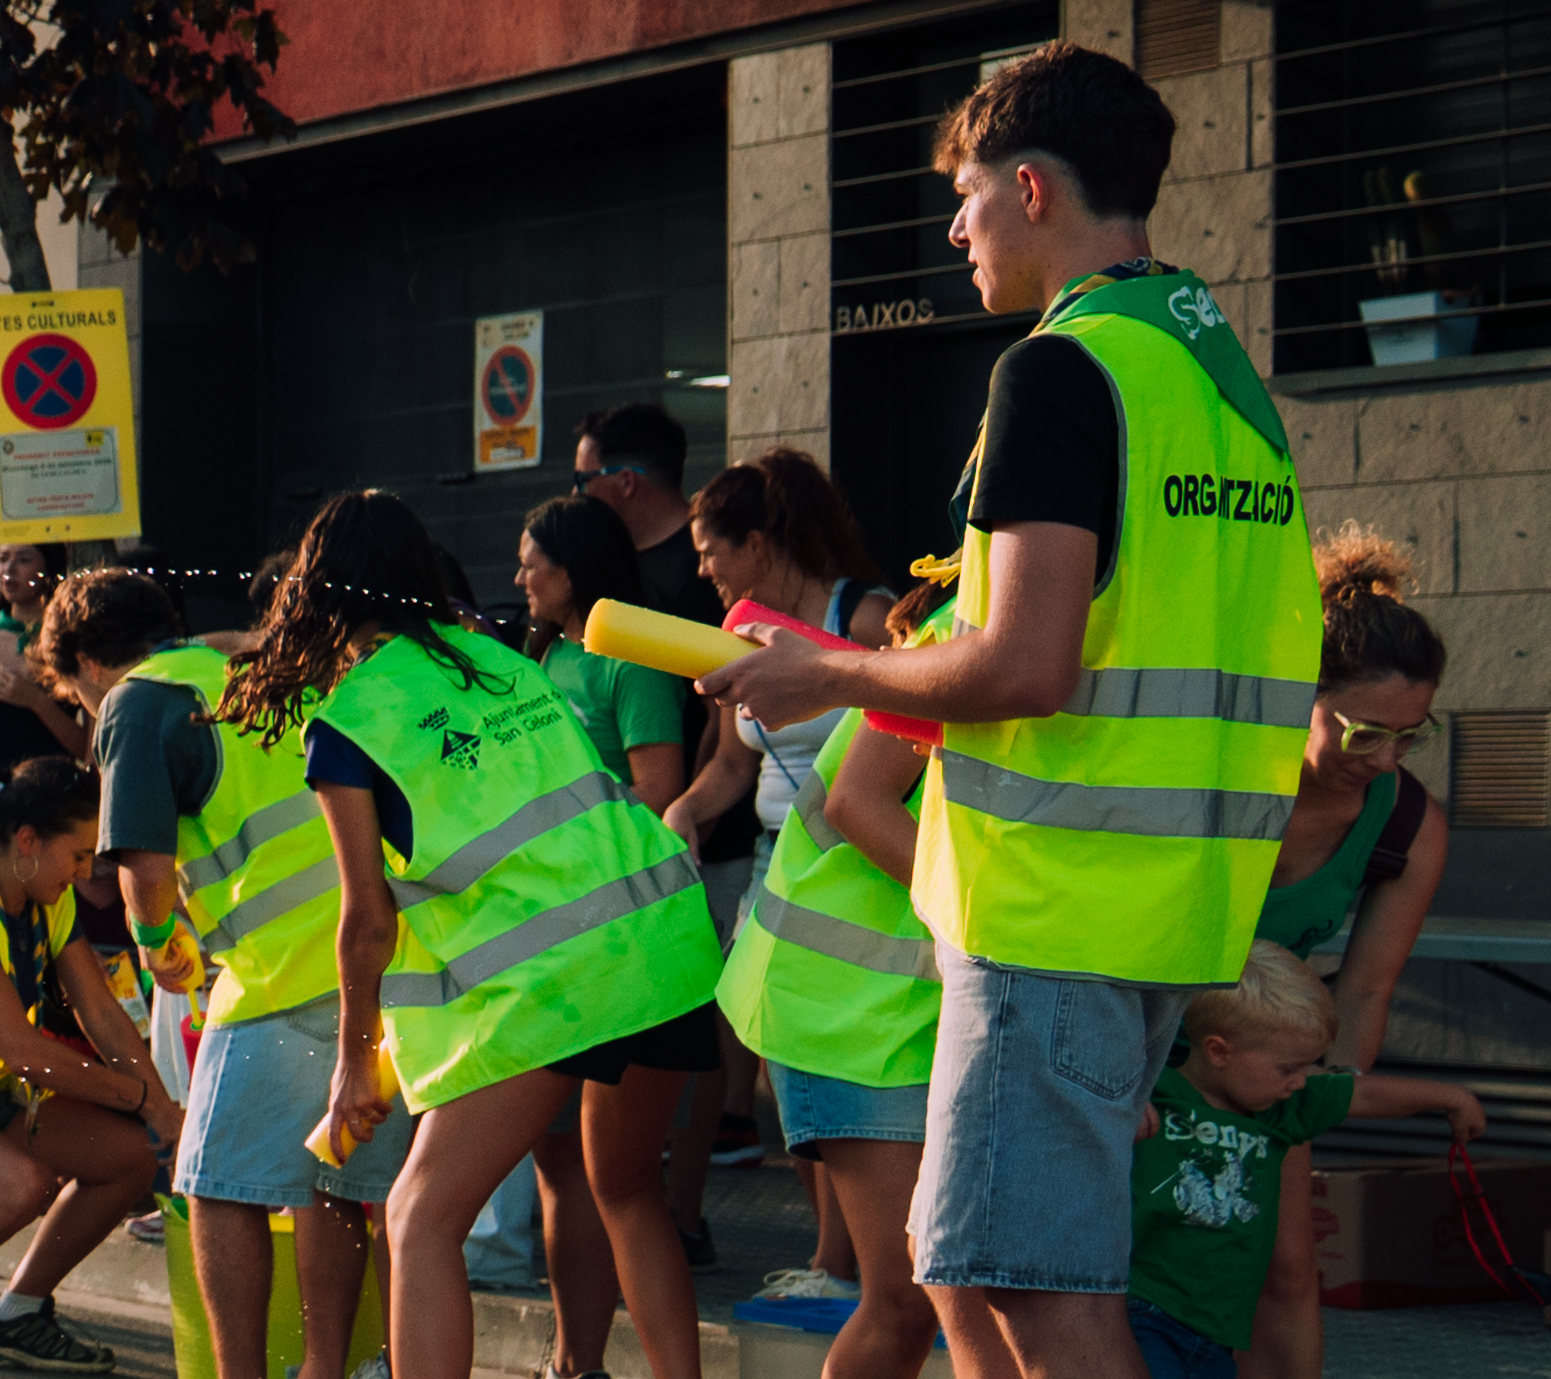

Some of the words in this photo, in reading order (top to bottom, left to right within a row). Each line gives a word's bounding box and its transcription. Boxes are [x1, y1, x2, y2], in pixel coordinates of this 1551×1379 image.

[27, 309, 117, 330] CULTURALS
[835, 298, 935, 333] BAIXOS
[1165, 1108, 1269, 1159] Senys
